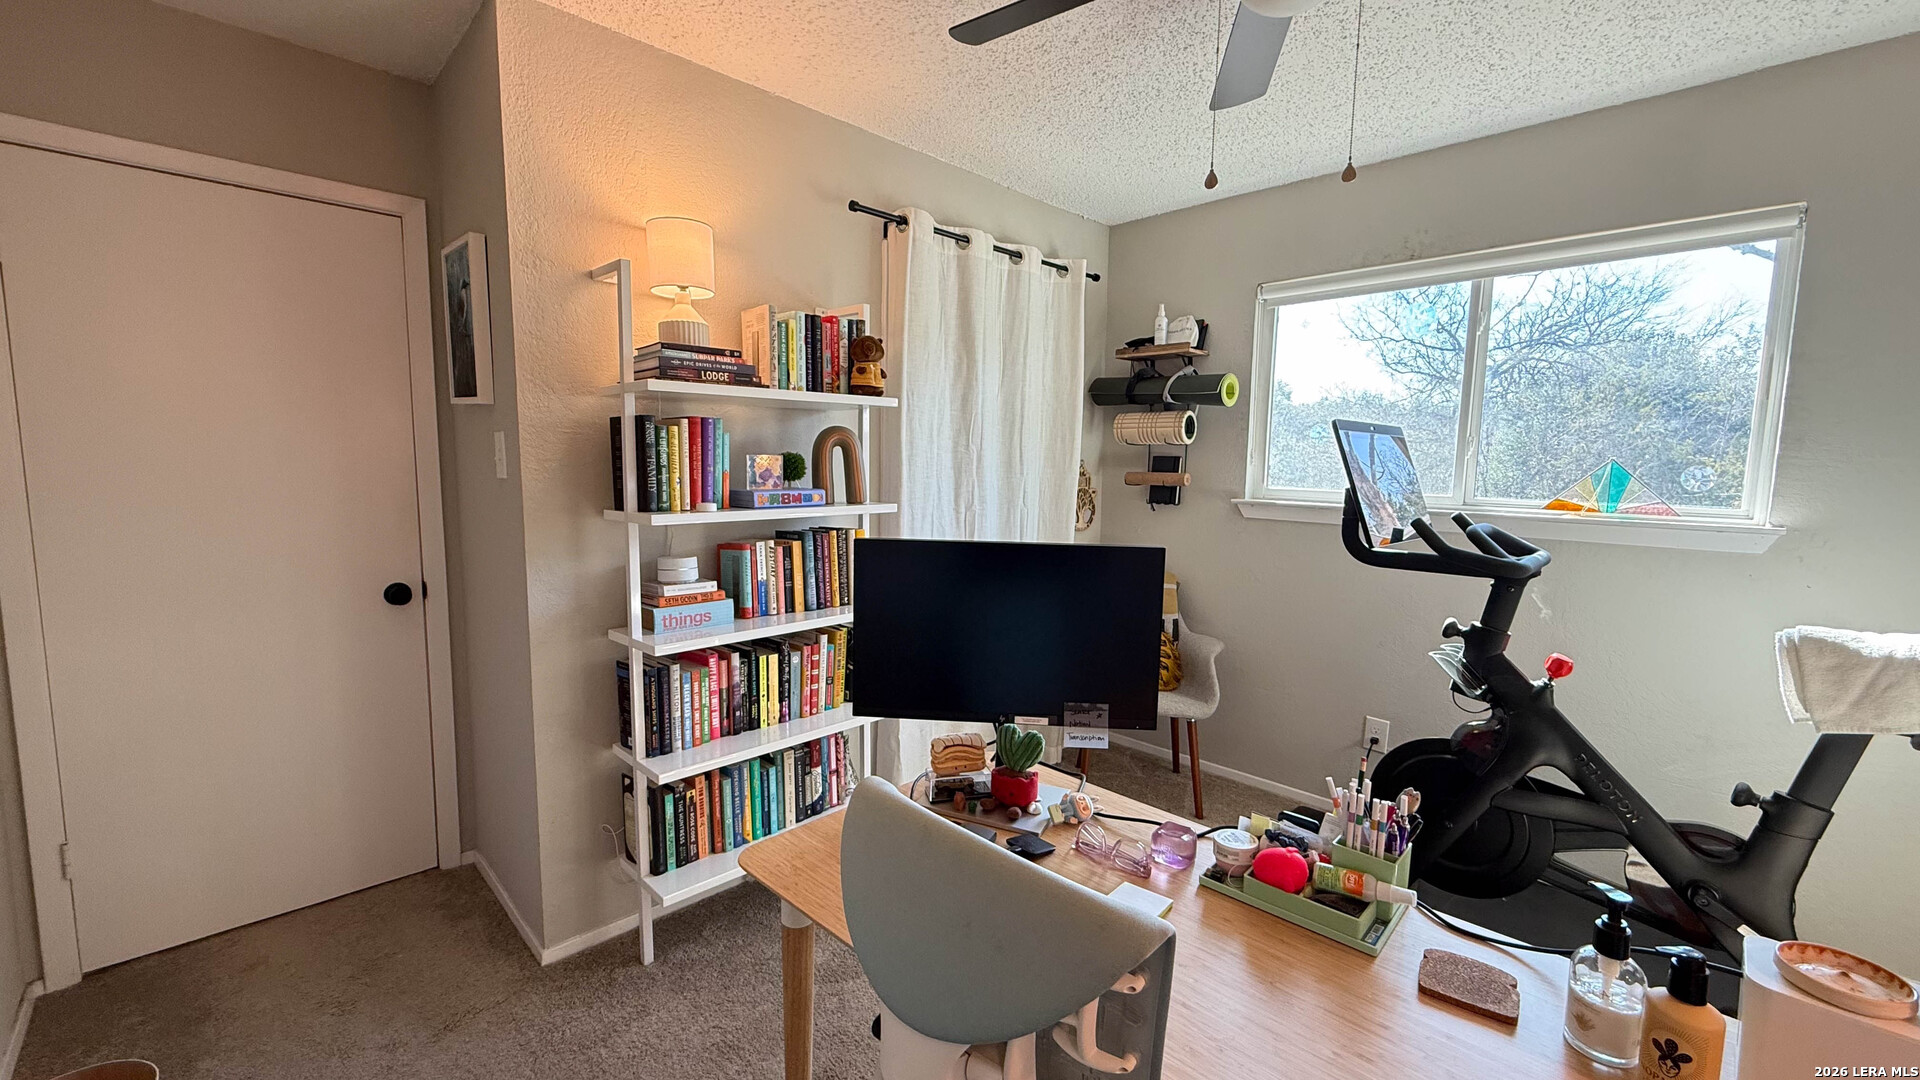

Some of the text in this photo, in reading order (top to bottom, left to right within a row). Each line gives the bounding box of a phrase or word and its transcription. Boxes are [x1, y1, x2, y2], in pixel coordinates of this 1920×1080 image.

[691, 353, 715, 362] SUBPAR
[716, 354, 735, 363] PARKS
[781, 343, 786, 352] ON
[701, 371, 729, 381] LODGE
[659, 438, 668, 466] LIFEGUARDS
[646, 455, 657, 493] FAMILY
[664, 595, 698, 605] SETH GODIN
[661, 612, 712, 629] things
[709, 658, 718, 691] HAPPY PLACE
[710, 694, 719, 728] EMILY HENRY
[1575, 753, 1644, 823] PELOTON
